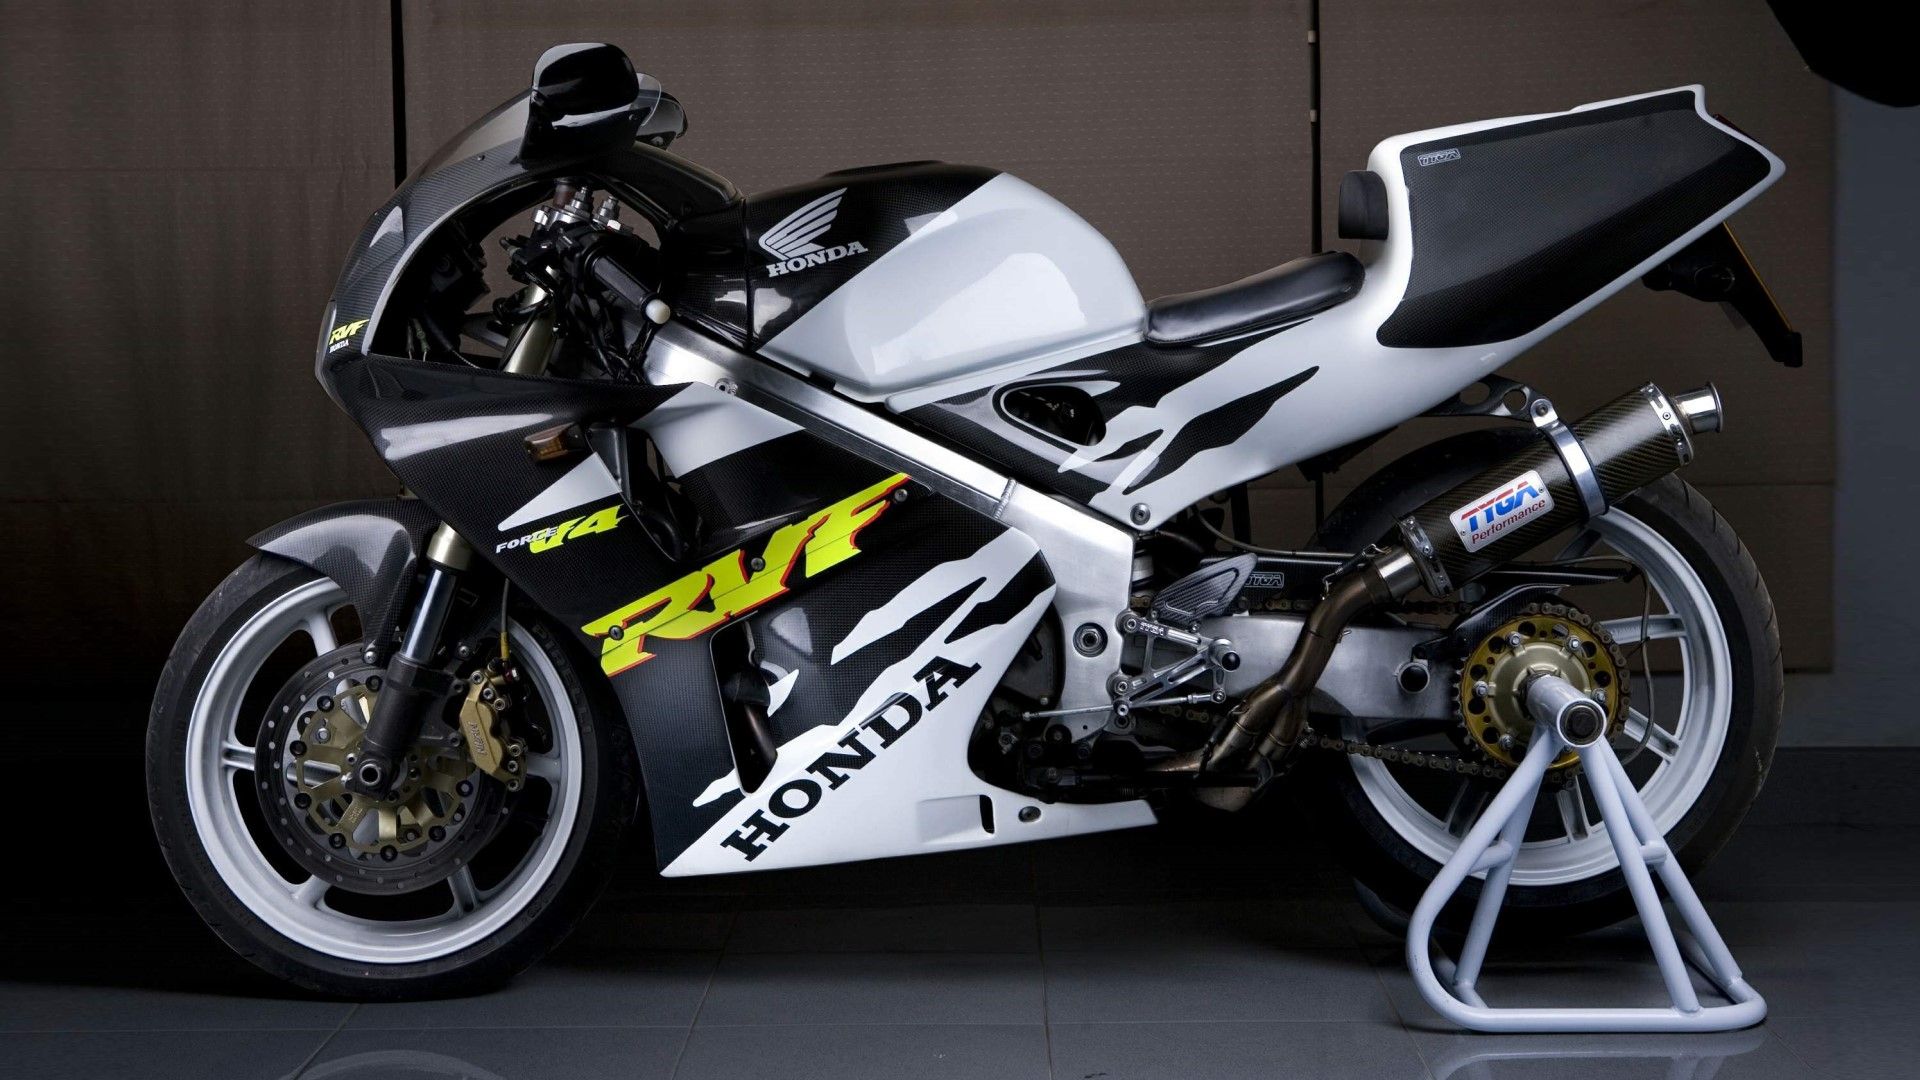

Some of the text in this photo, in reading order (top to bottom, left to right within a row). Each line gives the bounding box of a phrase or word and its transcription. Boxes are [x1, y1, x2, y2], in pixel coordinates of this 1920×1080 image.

[766, 241, 868, 278] HONDA
[329, 319, 370, 345] RVF
[495, 504, 630, 554] FORCE V4
[1461, 480, 1540, 532] TYGA
[1471, 499, 1545, 544] Performance
[581, 472, 912, 677] RVF
[531, 624, 593, 736] PIRELLI
[719, 655, 982, 862] HONDA
